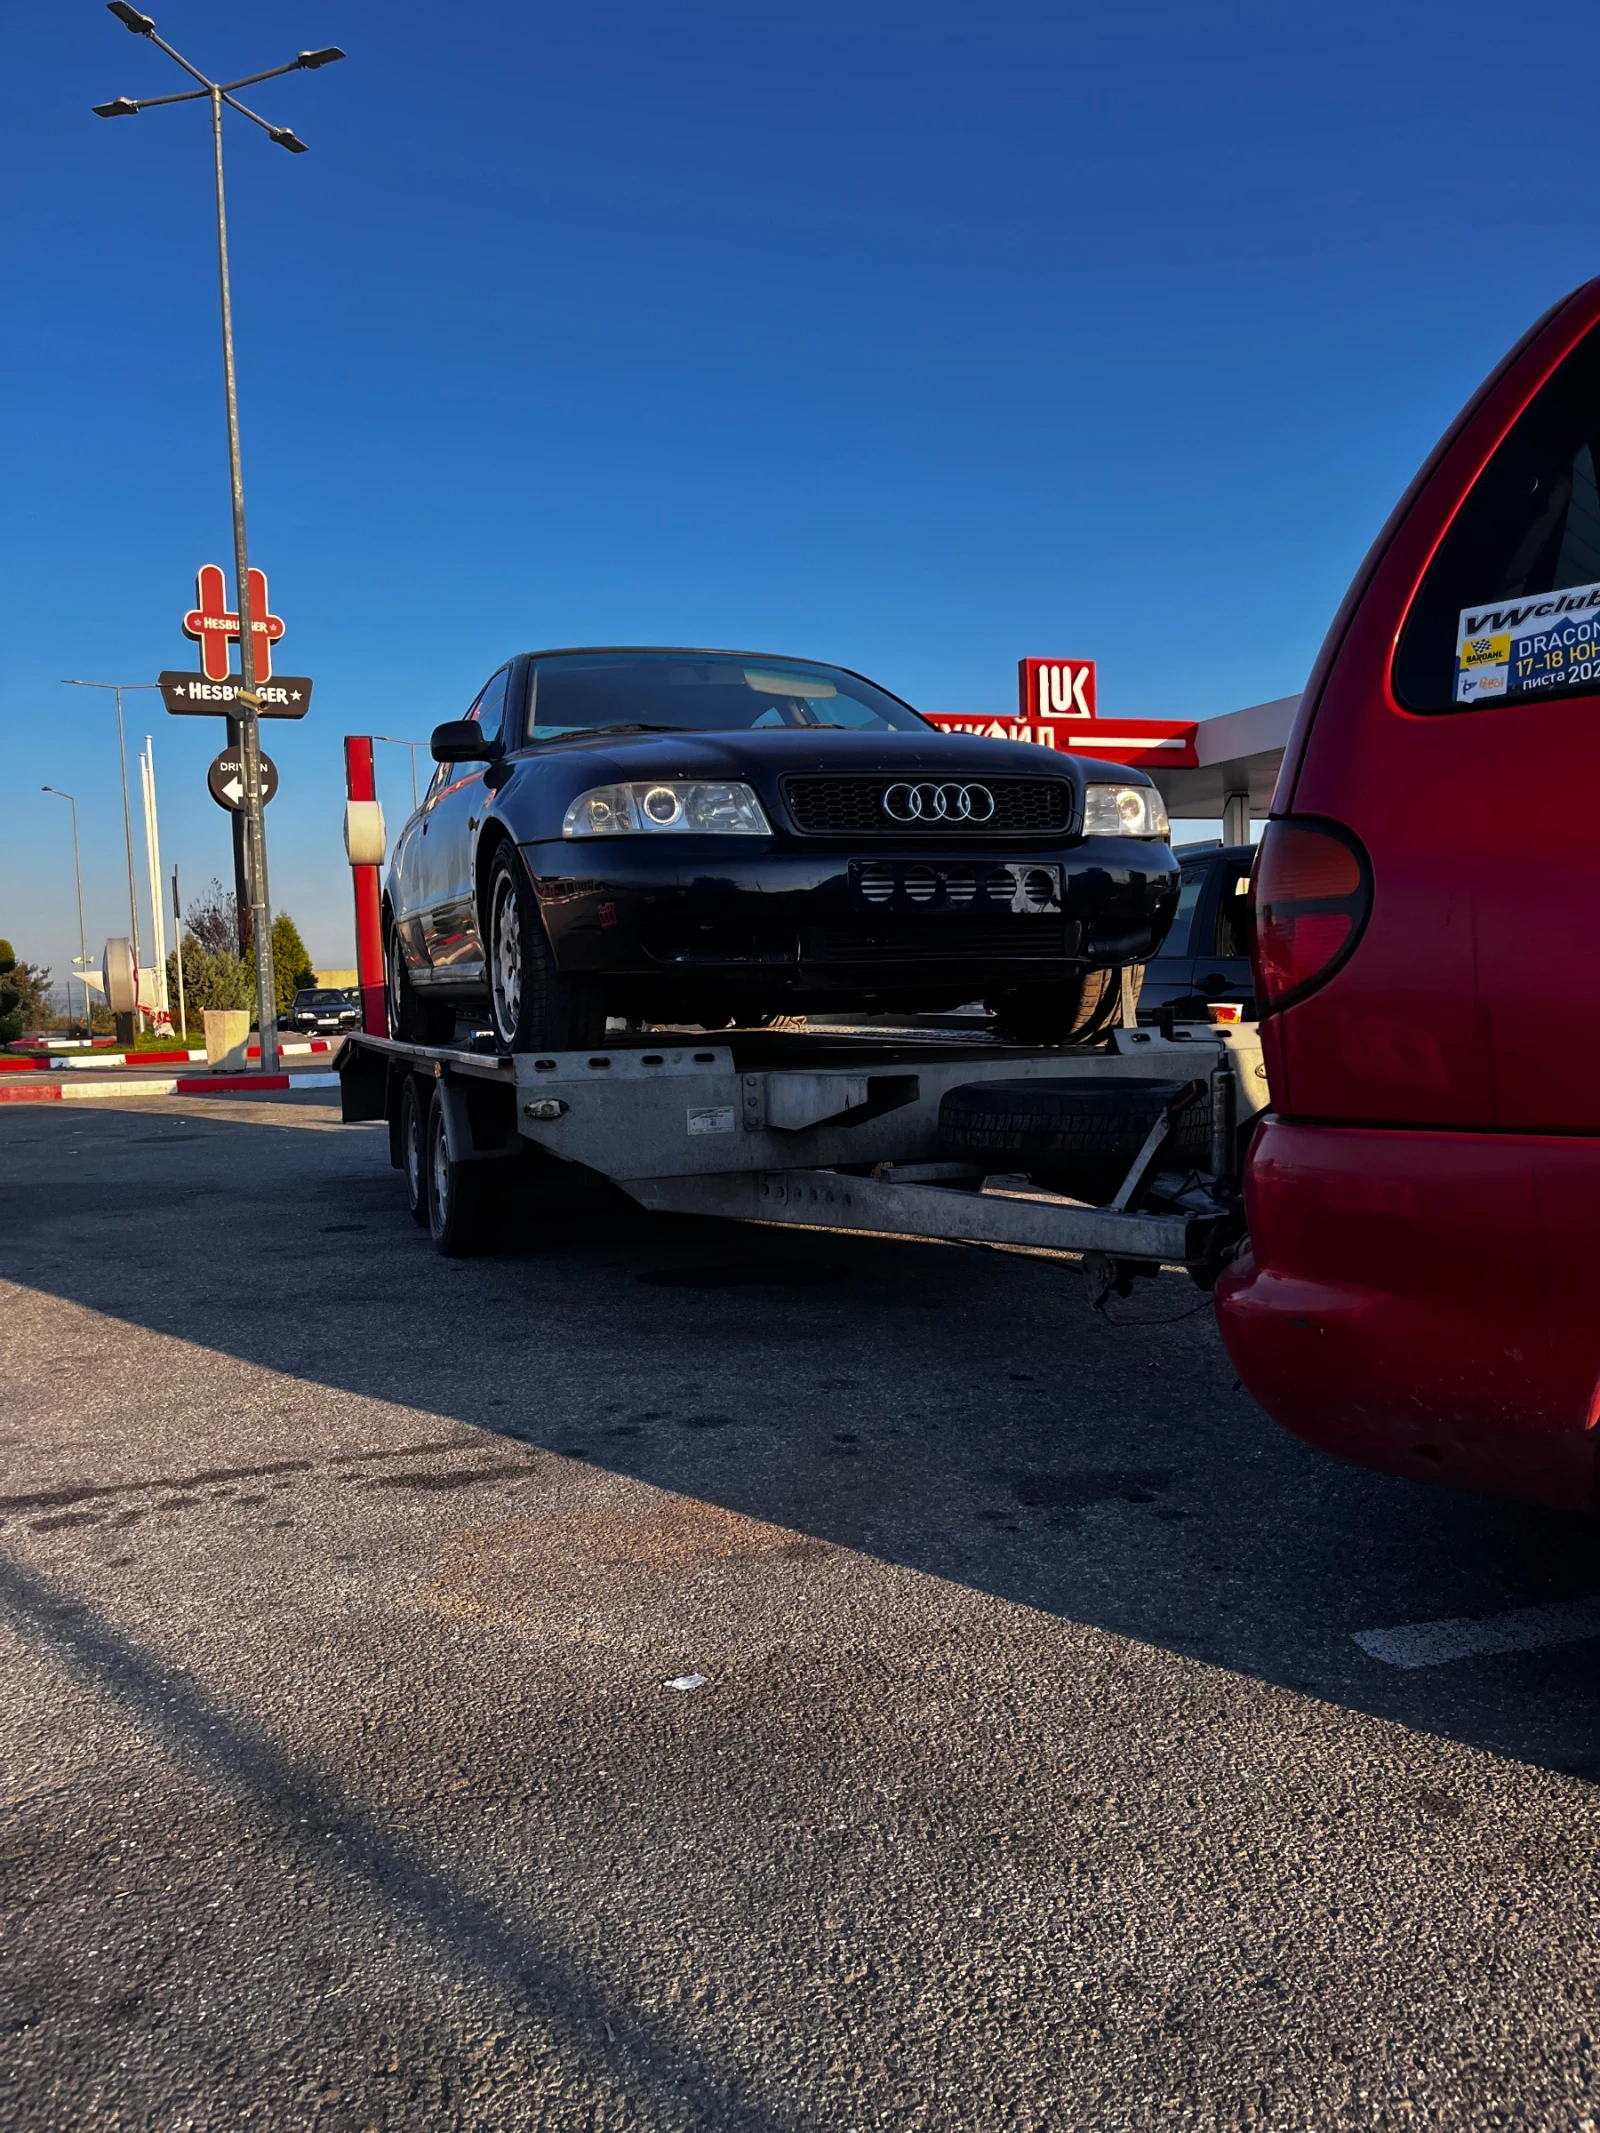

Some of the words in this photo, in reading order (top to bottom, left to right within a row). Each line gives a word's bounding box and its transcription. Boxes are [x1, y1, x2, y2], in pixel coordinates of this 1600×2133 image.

[204, 617, 268, 634] HESBUER
[1466, 650, 1503, 663] BARDAHL
[1516, 651, 1563, 677] 17-18
[189, 682, 289, 704] HESBGER
